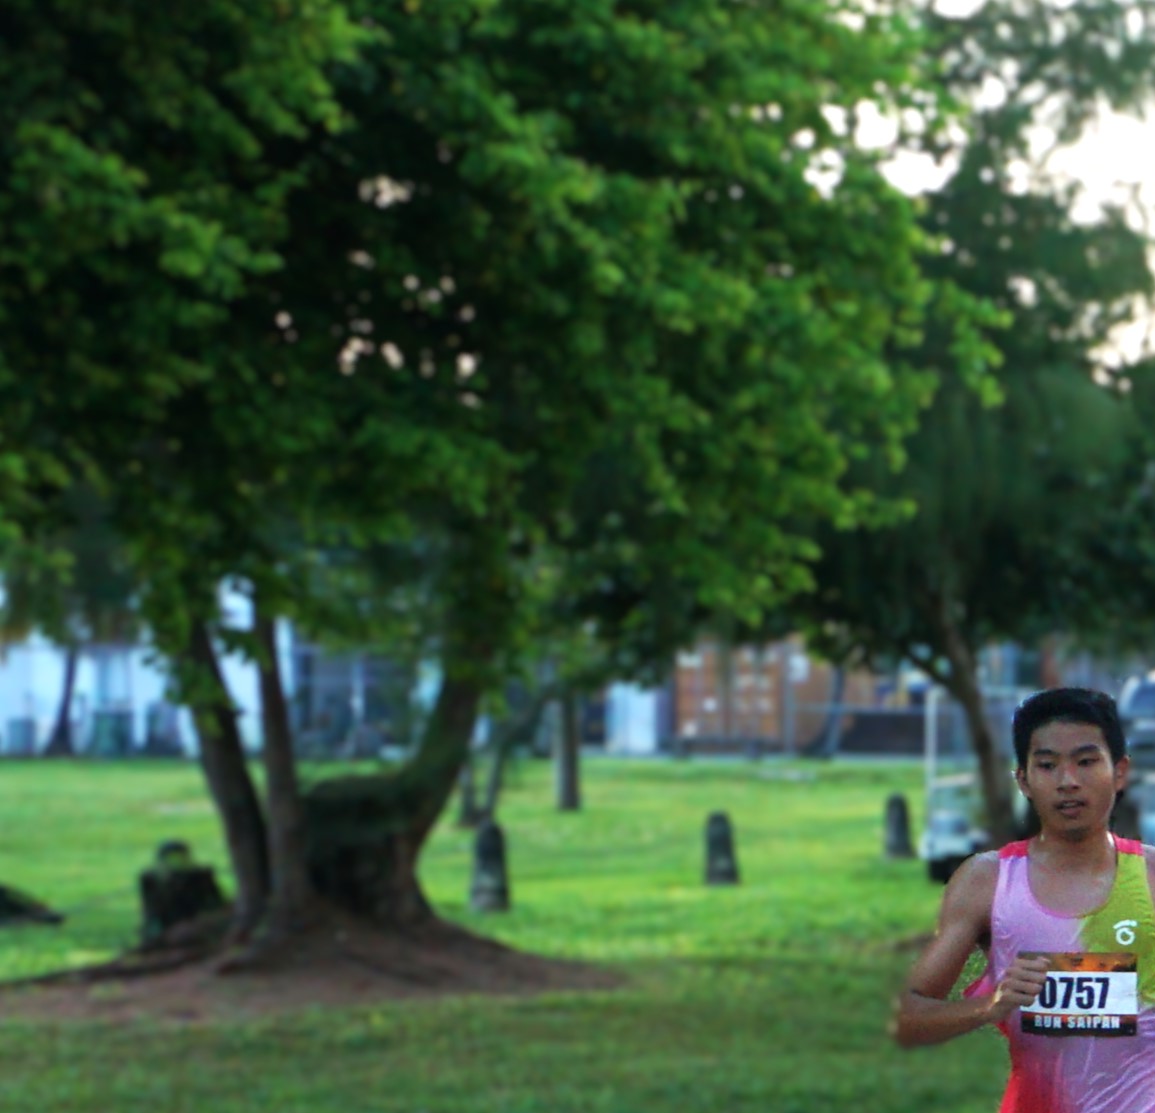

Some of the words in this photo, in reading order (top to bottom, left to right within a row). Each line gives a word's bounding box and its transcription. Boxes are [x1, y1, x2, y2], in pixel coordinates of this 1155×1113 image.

[1038, 976, 1110, 1009] 0757
[1034, 1015, 1062, 1028] RUN
[1067, 1016, 1120, 1029] SAIPAN
